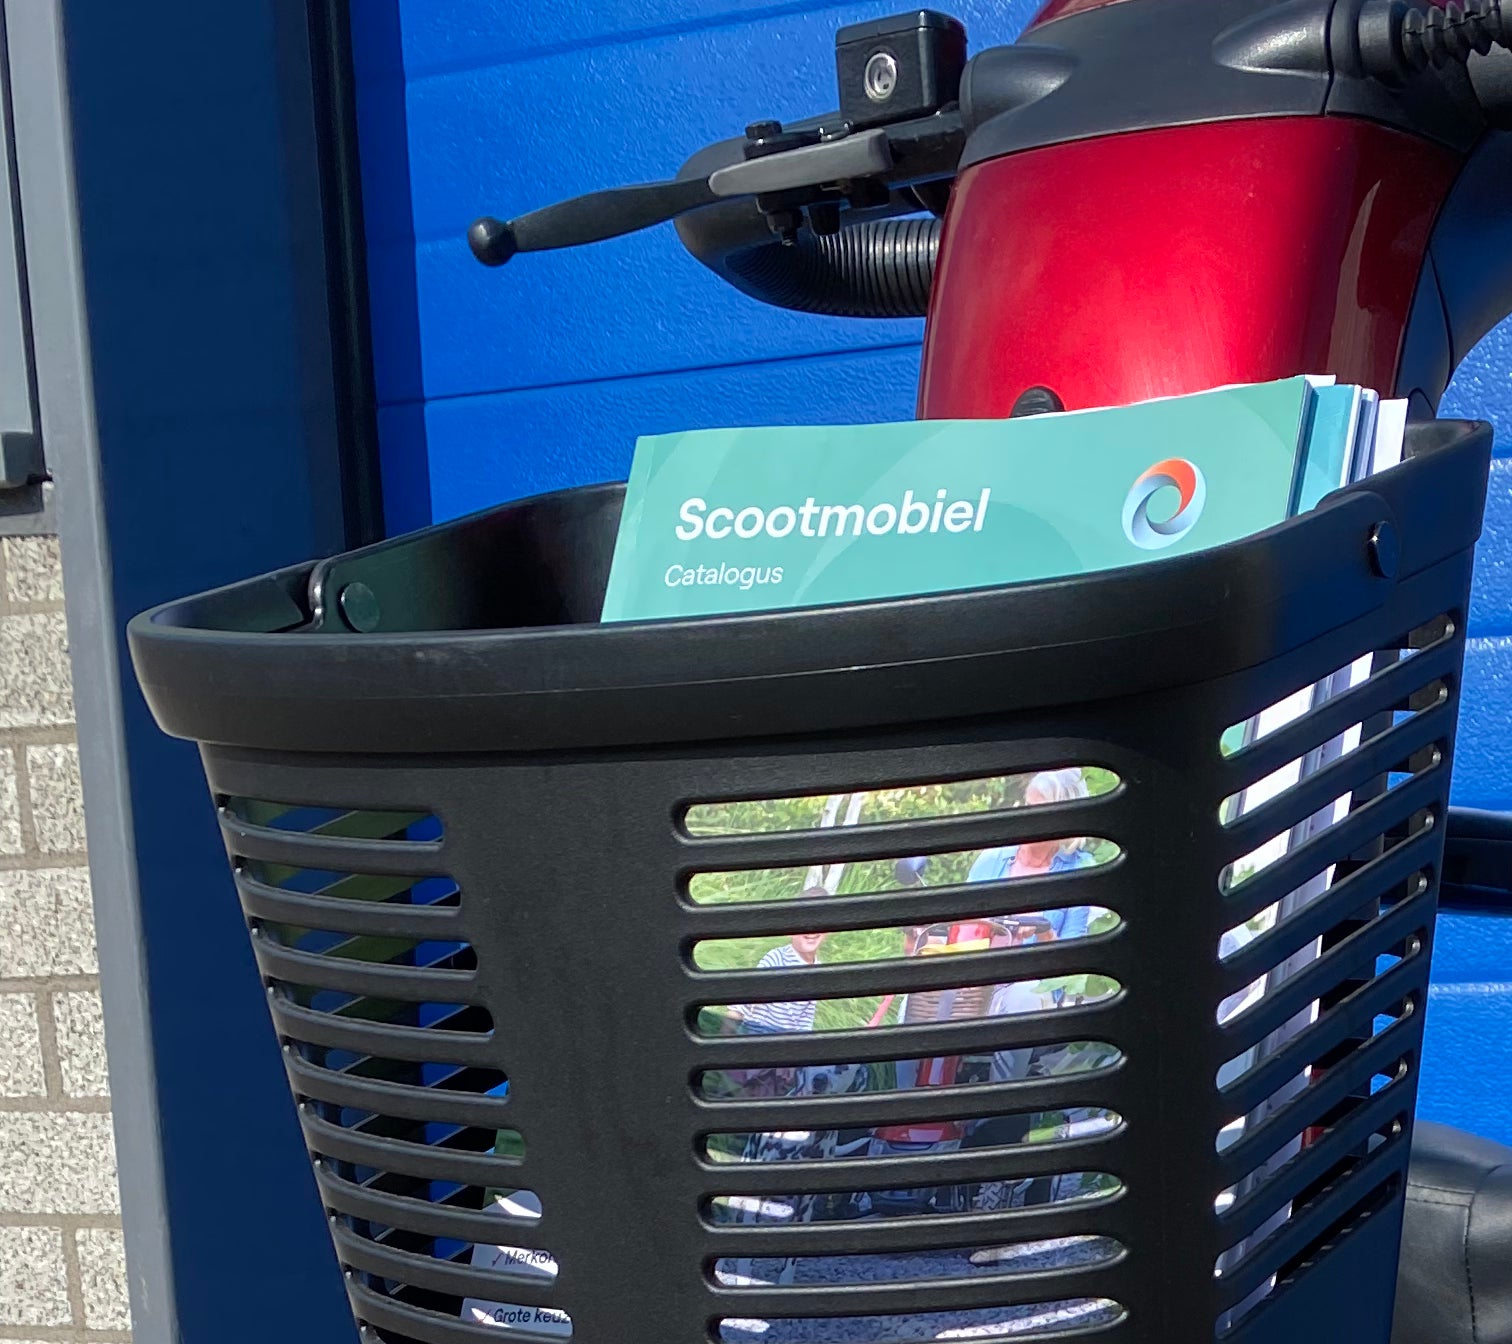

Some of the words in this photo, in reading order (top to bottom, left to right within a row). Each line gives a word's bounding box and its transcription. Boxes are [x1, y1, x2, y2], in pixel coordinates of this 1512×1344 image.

[675, 488, 991, 540] Scootmobiel
[664, 561, 784, 590] Catalogus
[494, 1308, 531, 1323] Grote
